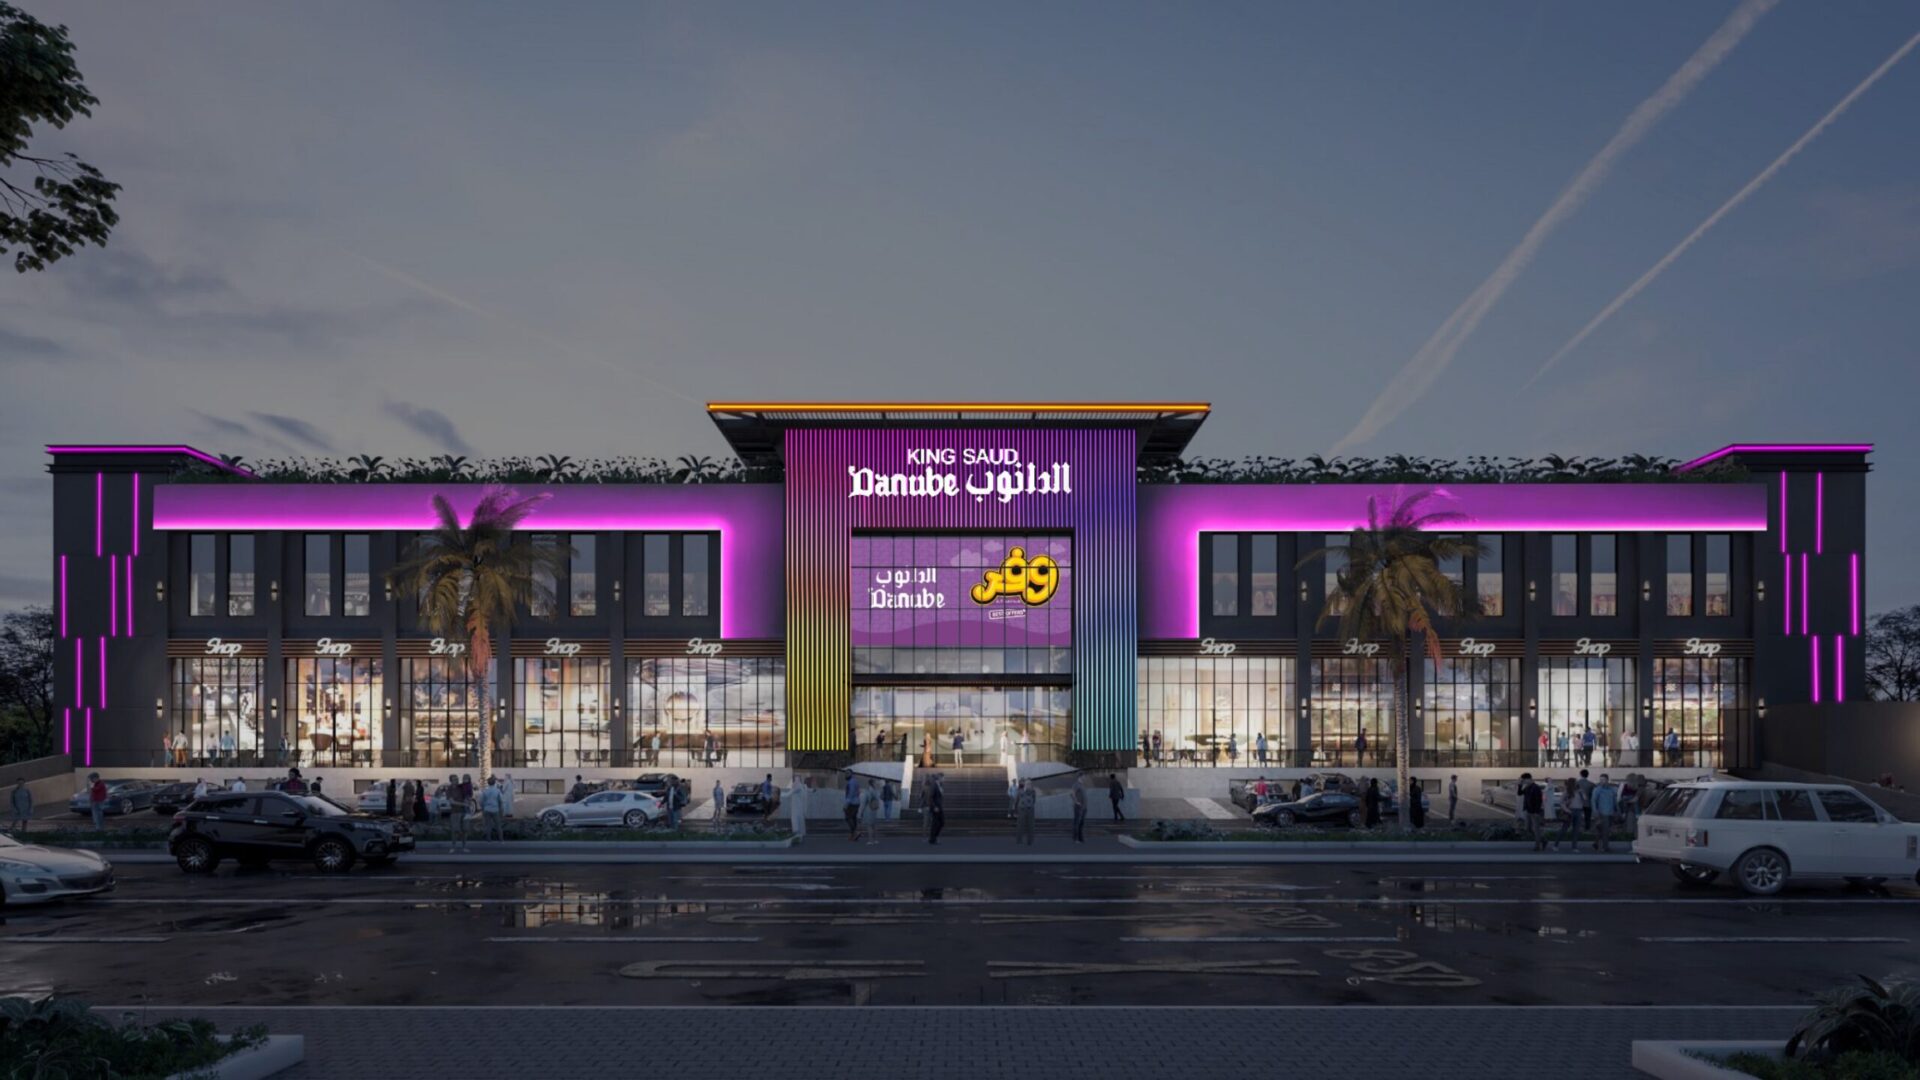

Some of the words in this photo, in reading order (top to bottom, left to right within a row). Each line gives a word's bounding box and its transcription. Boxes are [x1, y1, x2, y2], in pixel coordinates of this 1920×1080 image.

[907, 448, 956, 465] KING
[962, 448, 1019, 465] SAUD
[848, 465, 960, 498] Danube
[965, 461, 1072, 503] الدانوب
[970, 546, 1060, 606] وفر
[867, 587, 946, 609] Danube
[205, 637, 242, 658] Shop
[315, 637, 351, 658] Shop
[428, 637, 465, 658] Shop
[543, 637, 581, 658] Shop
[686, 637, 722, 658] Shop
[1200, 637, 1236, 658] Shop
[1458, 637, 1496, 658] Shop
[1574, 637, 1611, 658] Shop
[1683, 637, 1721, 658] Shop
